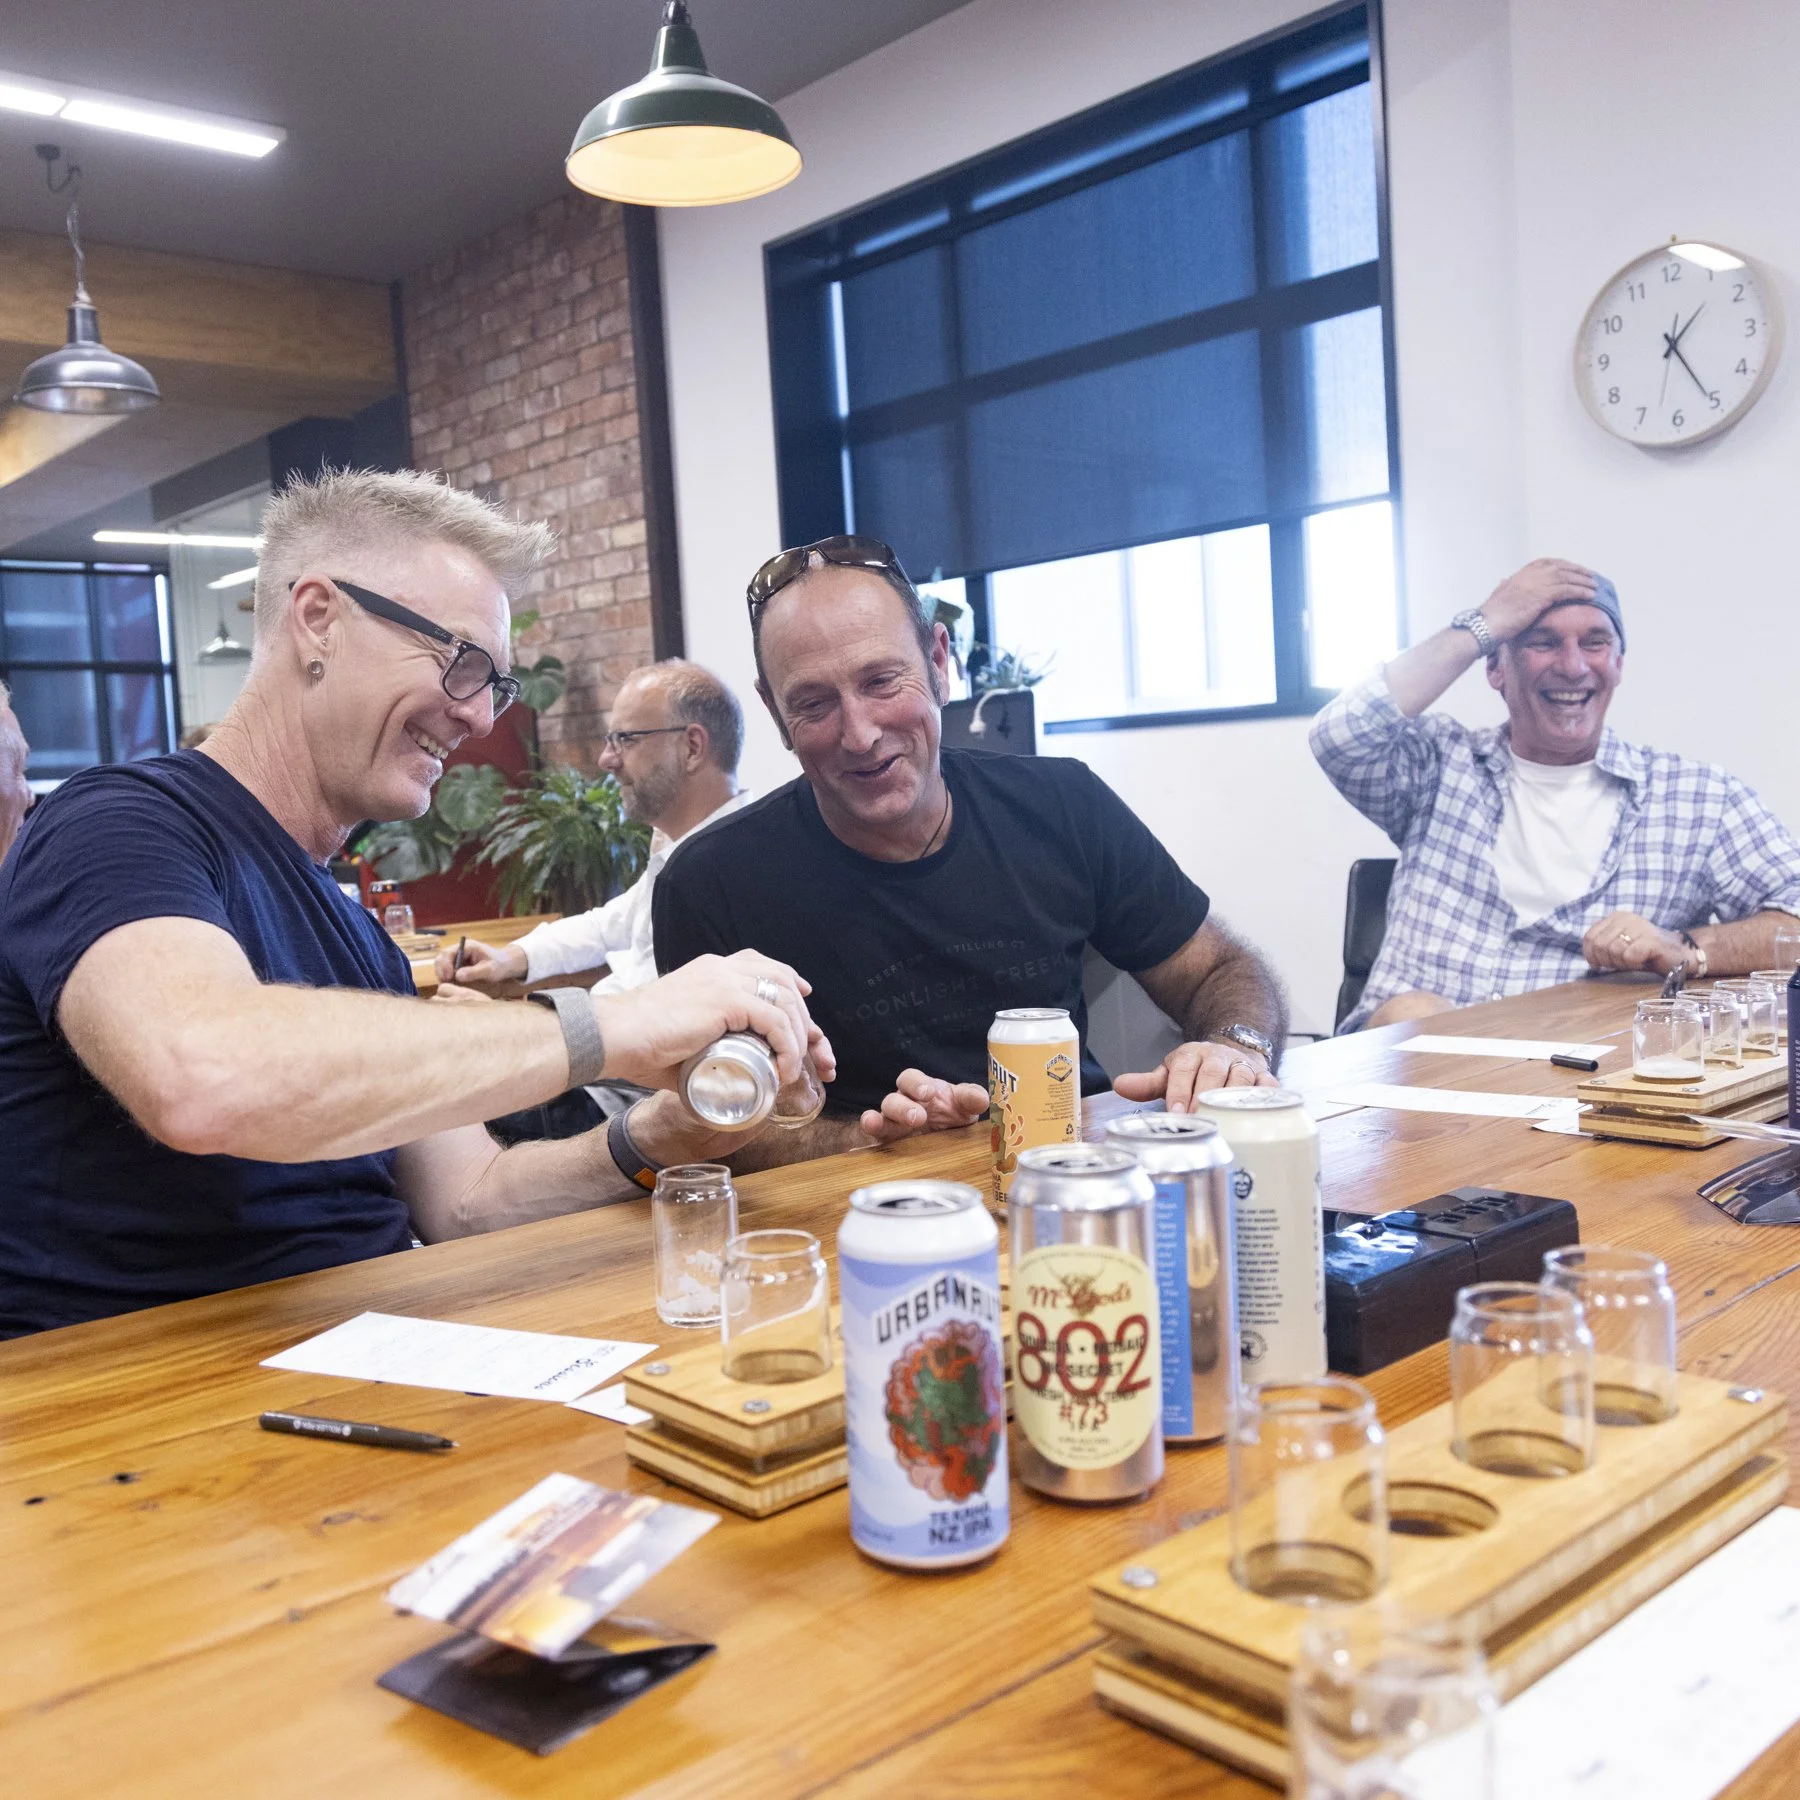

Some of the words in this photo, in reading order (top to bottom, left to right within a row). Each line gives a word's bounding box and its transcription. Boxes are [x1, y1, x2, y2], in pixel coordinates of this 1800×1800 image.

[1662, 263, 1682, 282] 12
[1628, 283, 1646, 301] 11
[1732, 284, 1744, 302] 2
[1602, 315, 1623, 334] 10
[1744, 318, 1756, 337] 3
[1598, 353, 1610, 371] 9
[1734, 358, 1748, 375] 4
[1608, 387, 1621, 404] 8
[1708, 390, 1721, 409] 5
[1636, 407, 1647, 425] 7
[1672, 409, 1684, 427] 6
[1017, 1312, 1152, 1402] 802
[929, 1525, 960, 1545] NZ
